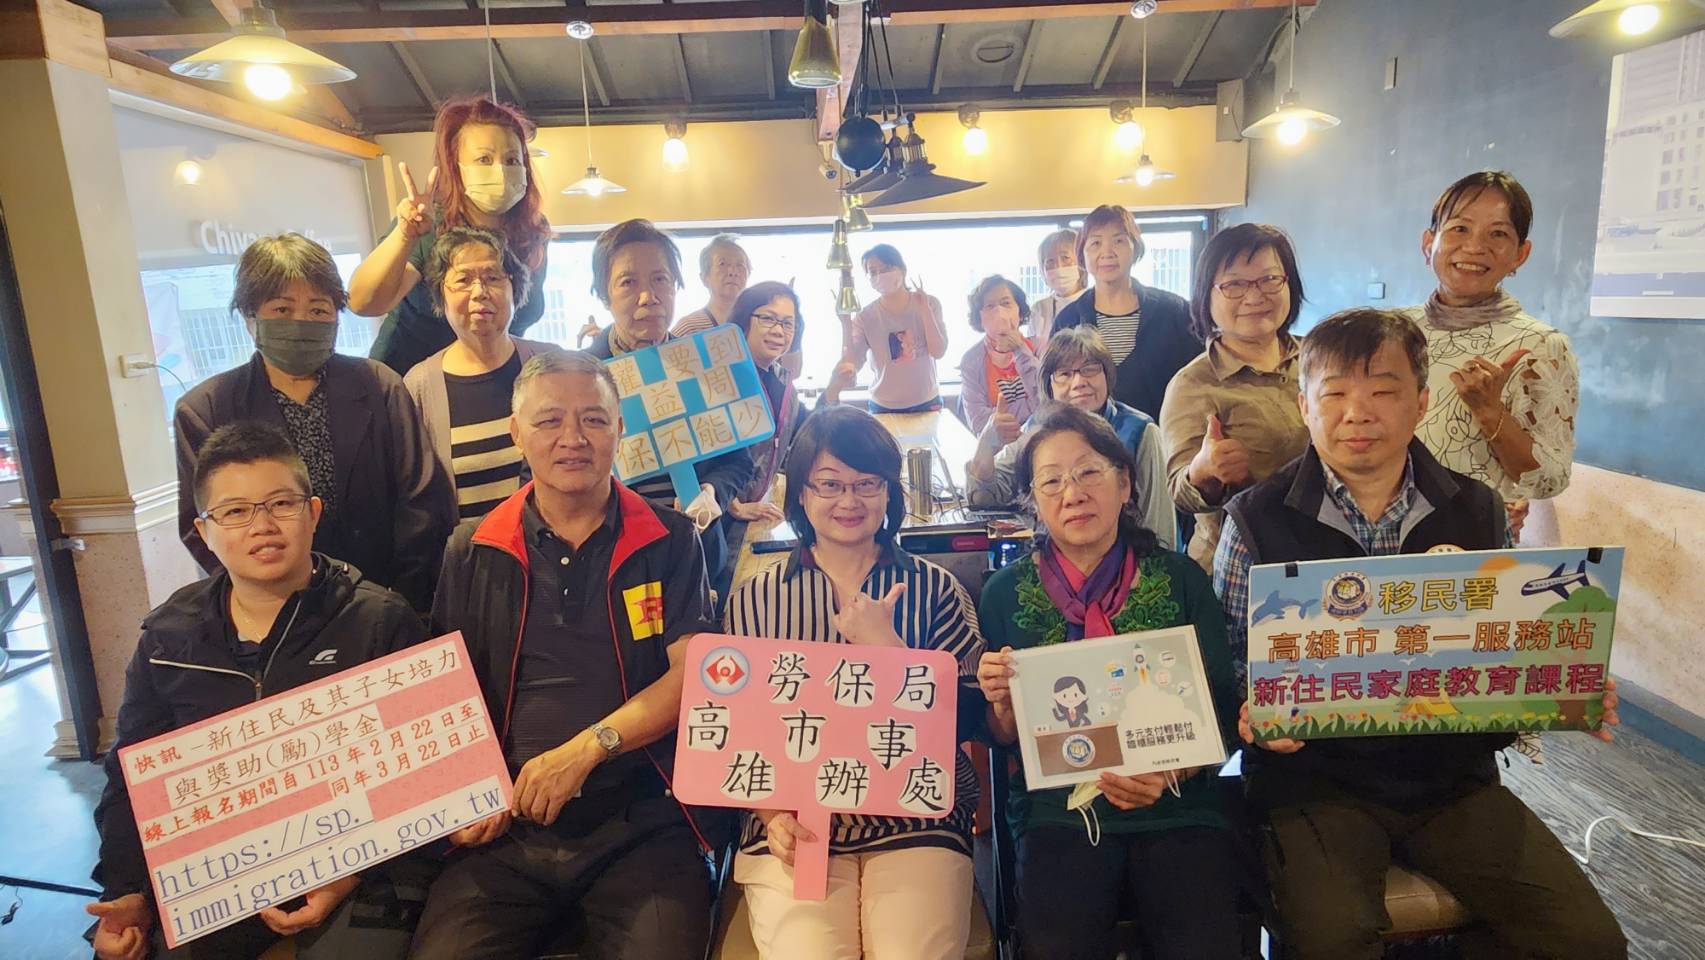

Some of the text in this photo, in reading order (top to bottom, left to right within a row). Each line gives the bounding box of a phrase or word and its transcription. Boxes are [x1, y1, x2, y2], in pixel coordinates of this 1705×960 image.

[1378, 577, 1498, 615] 移民署
[1267, 618, 1596, 664] 高雄市 第一服務站
[768, 653, 936, 710] 勞保局
[1253, 663, 1605, 707] 新住民家庭教育課程
[155, 806, 361, 899] https://sp.
